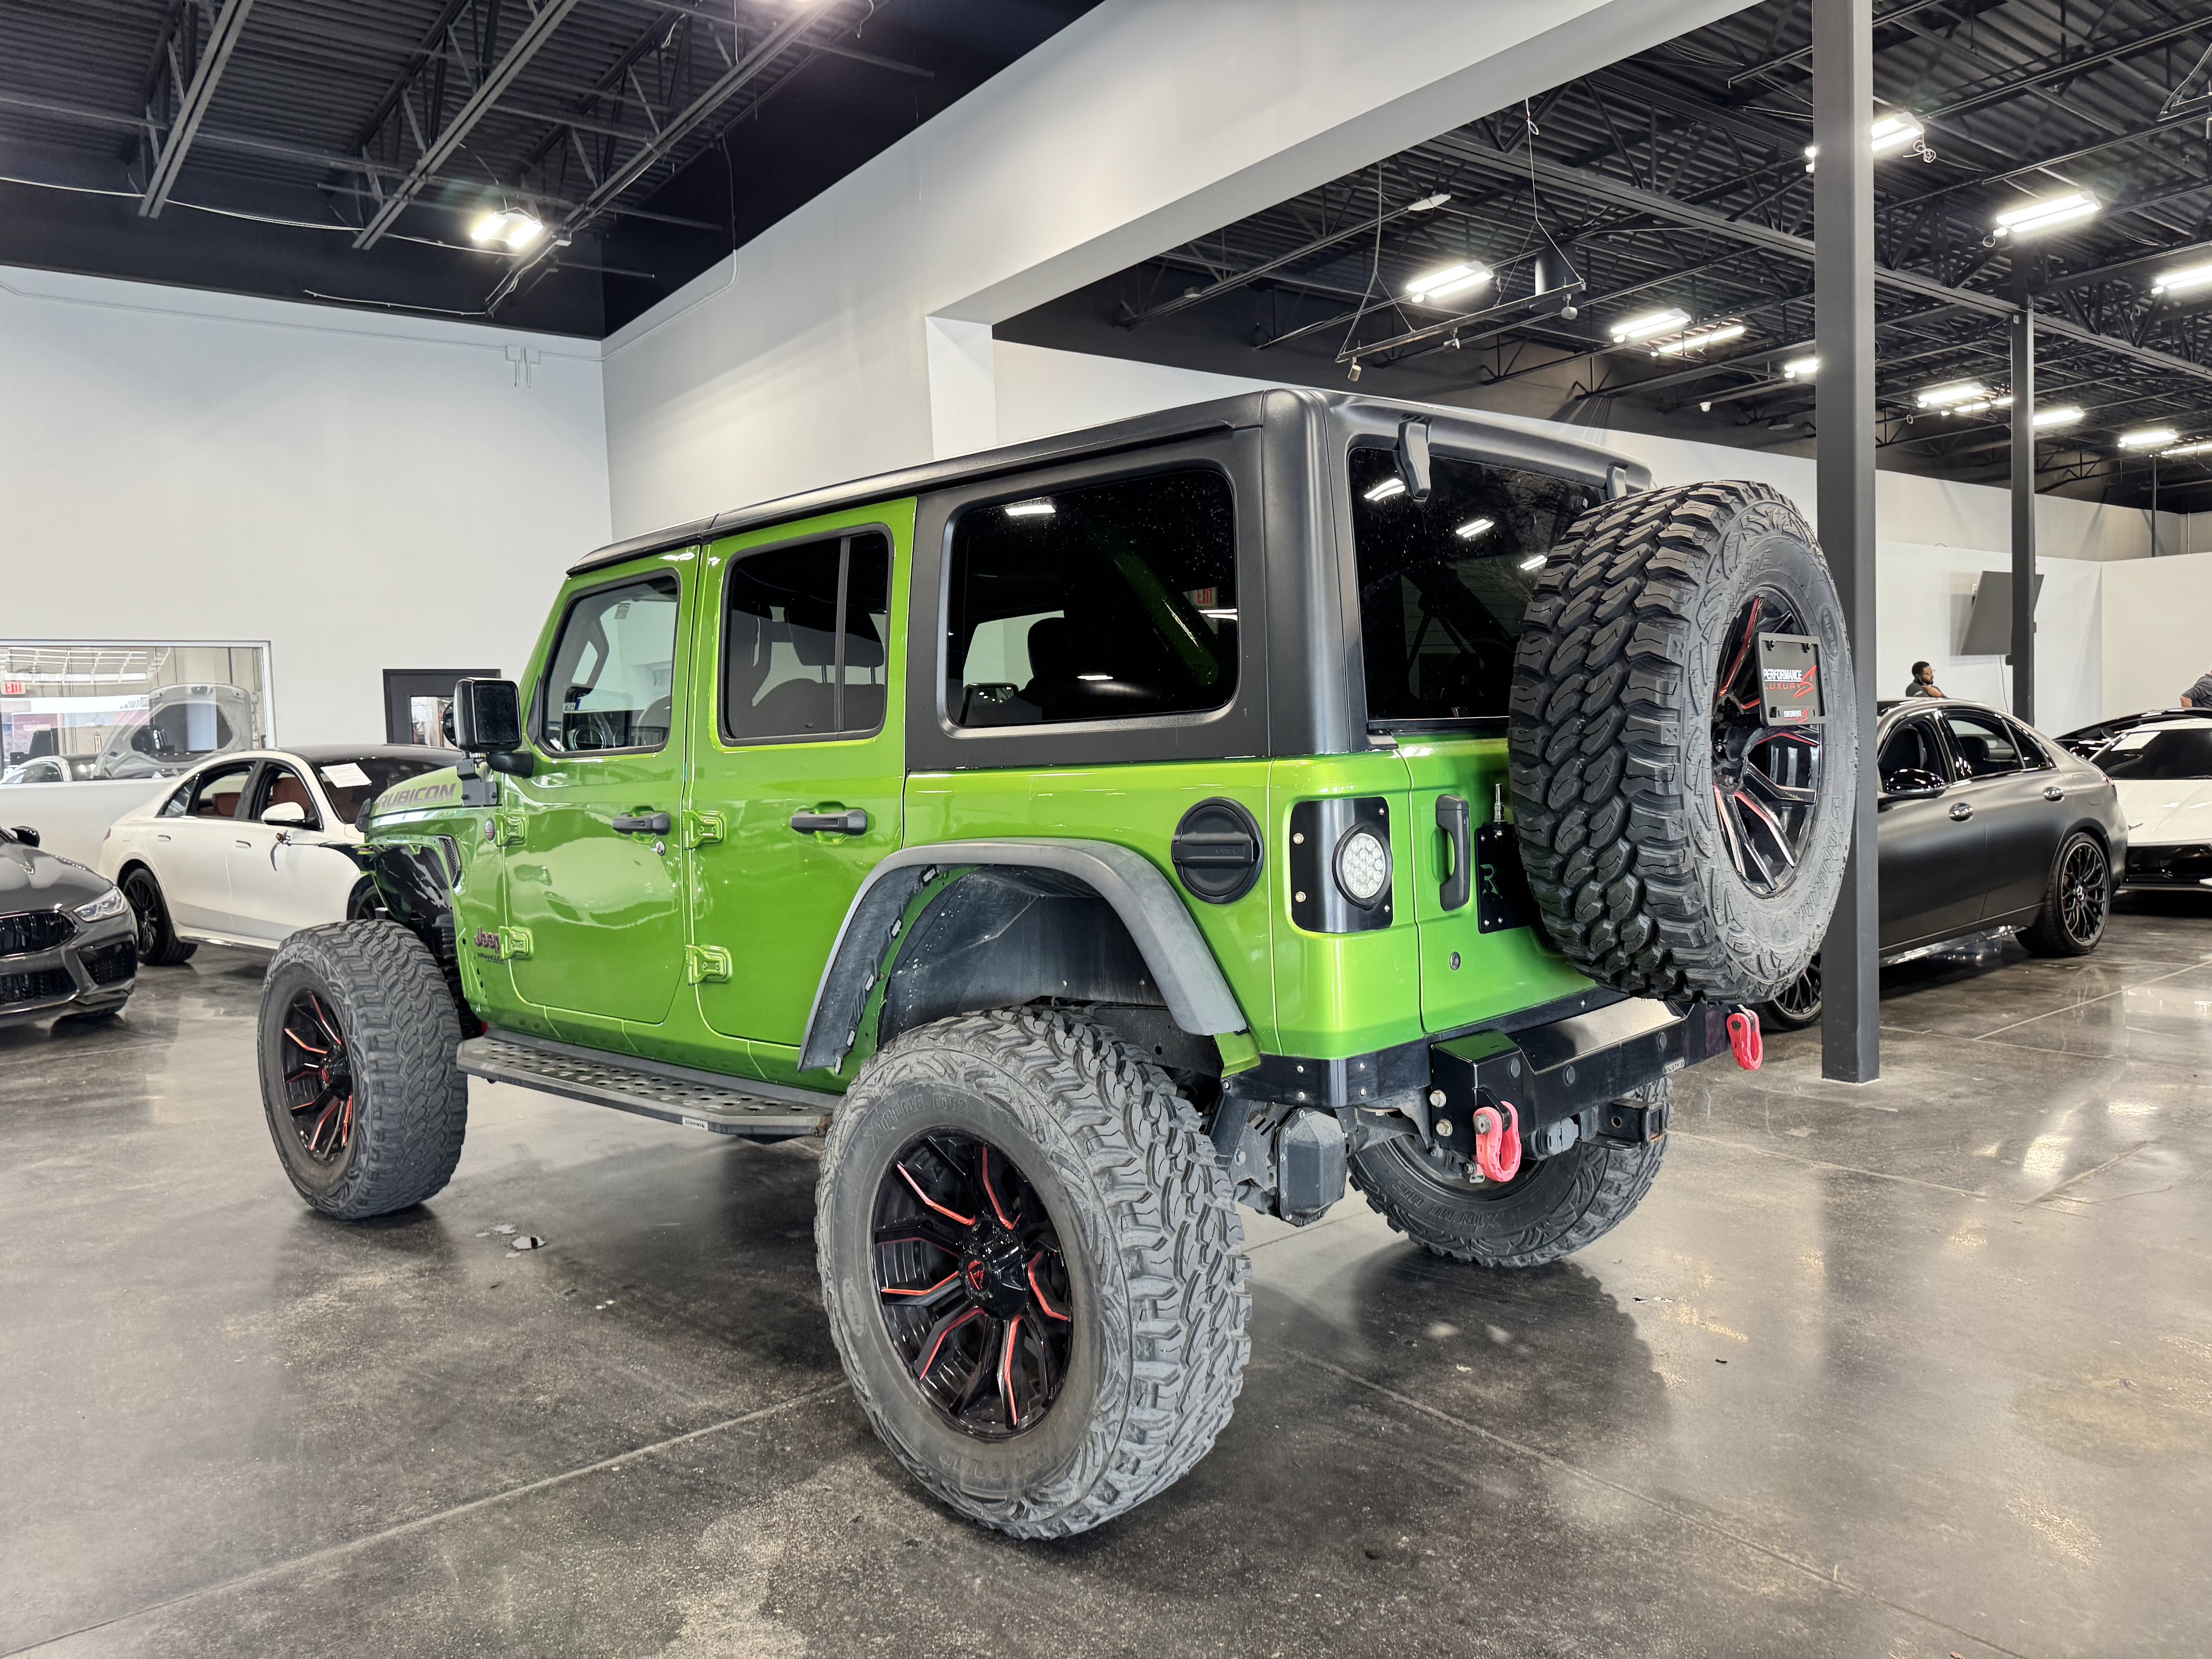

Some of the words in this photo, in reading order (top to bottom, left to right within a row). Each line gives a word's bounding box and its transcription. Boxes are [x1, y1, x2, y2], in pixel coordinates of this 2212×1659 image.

[1197, 589, 1213, 604] EXIT
[1763, 669, 1802, 680] PERFORMANCE
[5, 682, 22, 694] EXIT
[378, 783, 456, 809] RUBICON
[932, 1093, 968, 1115] MT2
